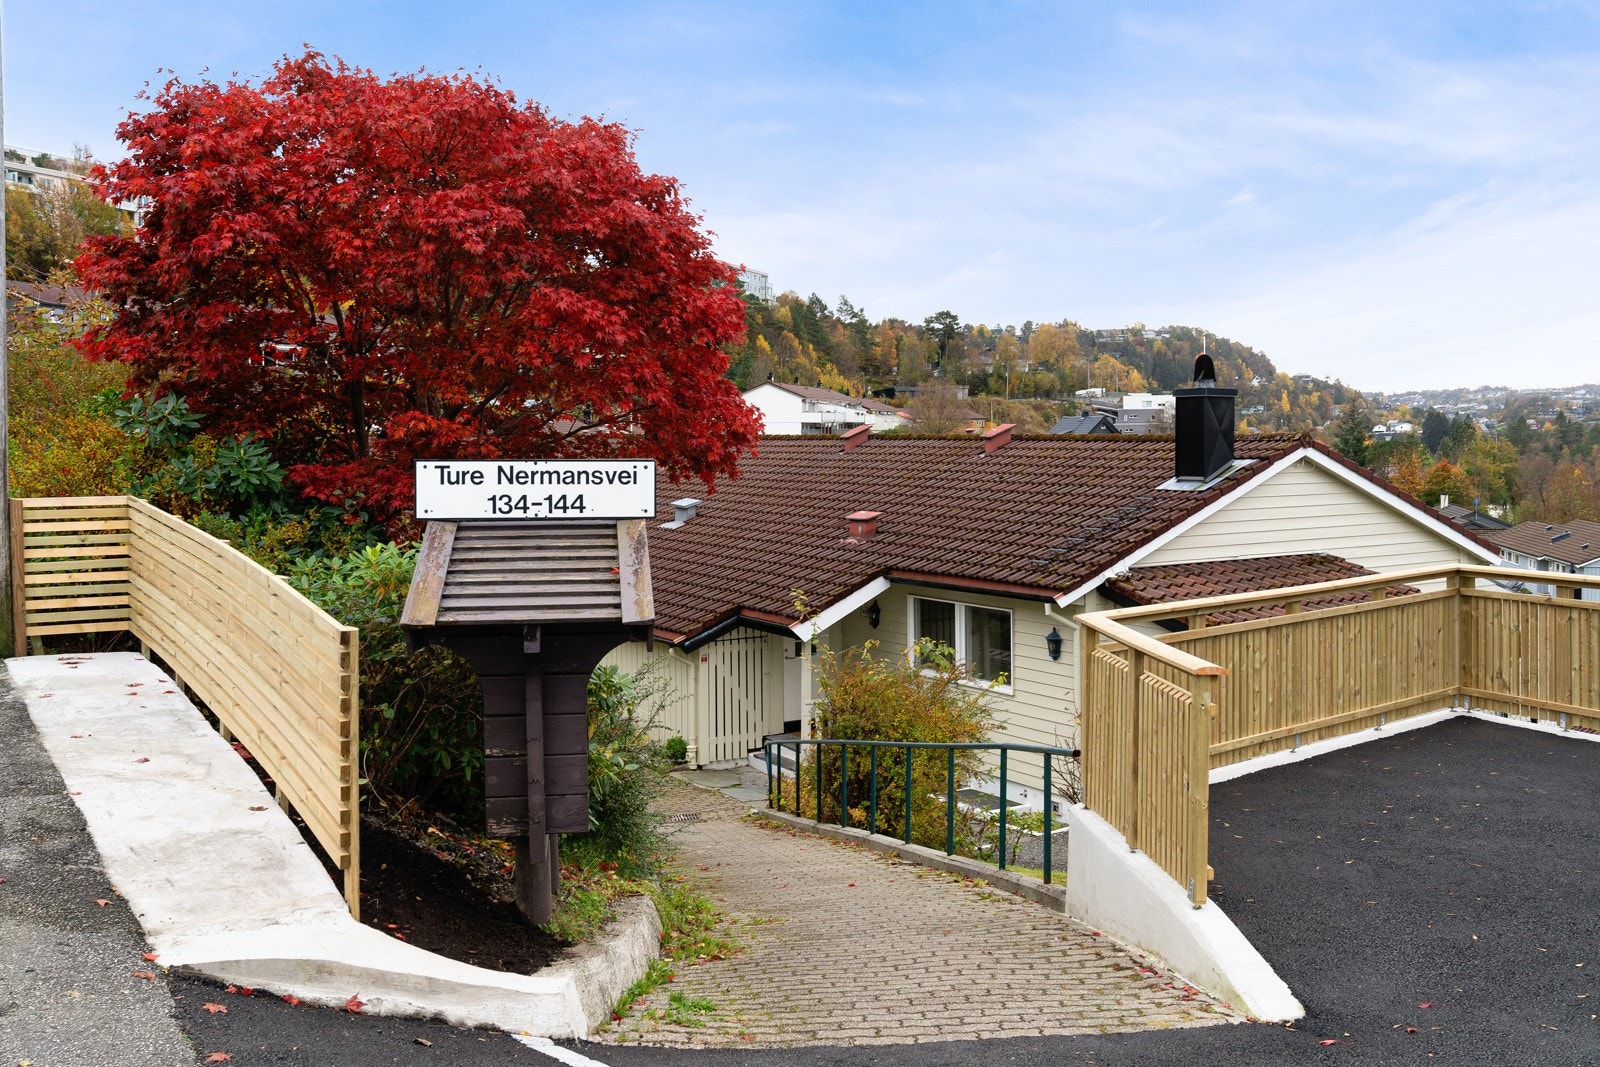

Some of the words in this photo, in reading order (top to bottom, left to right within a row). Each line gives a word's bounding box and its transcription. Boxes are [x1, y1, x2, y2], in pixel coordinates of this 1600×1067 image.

[434, 465, 485, 486] Ture
[497, 465, 638, 486] Nermansvei
[487, 494, 587, 515] 134-144
